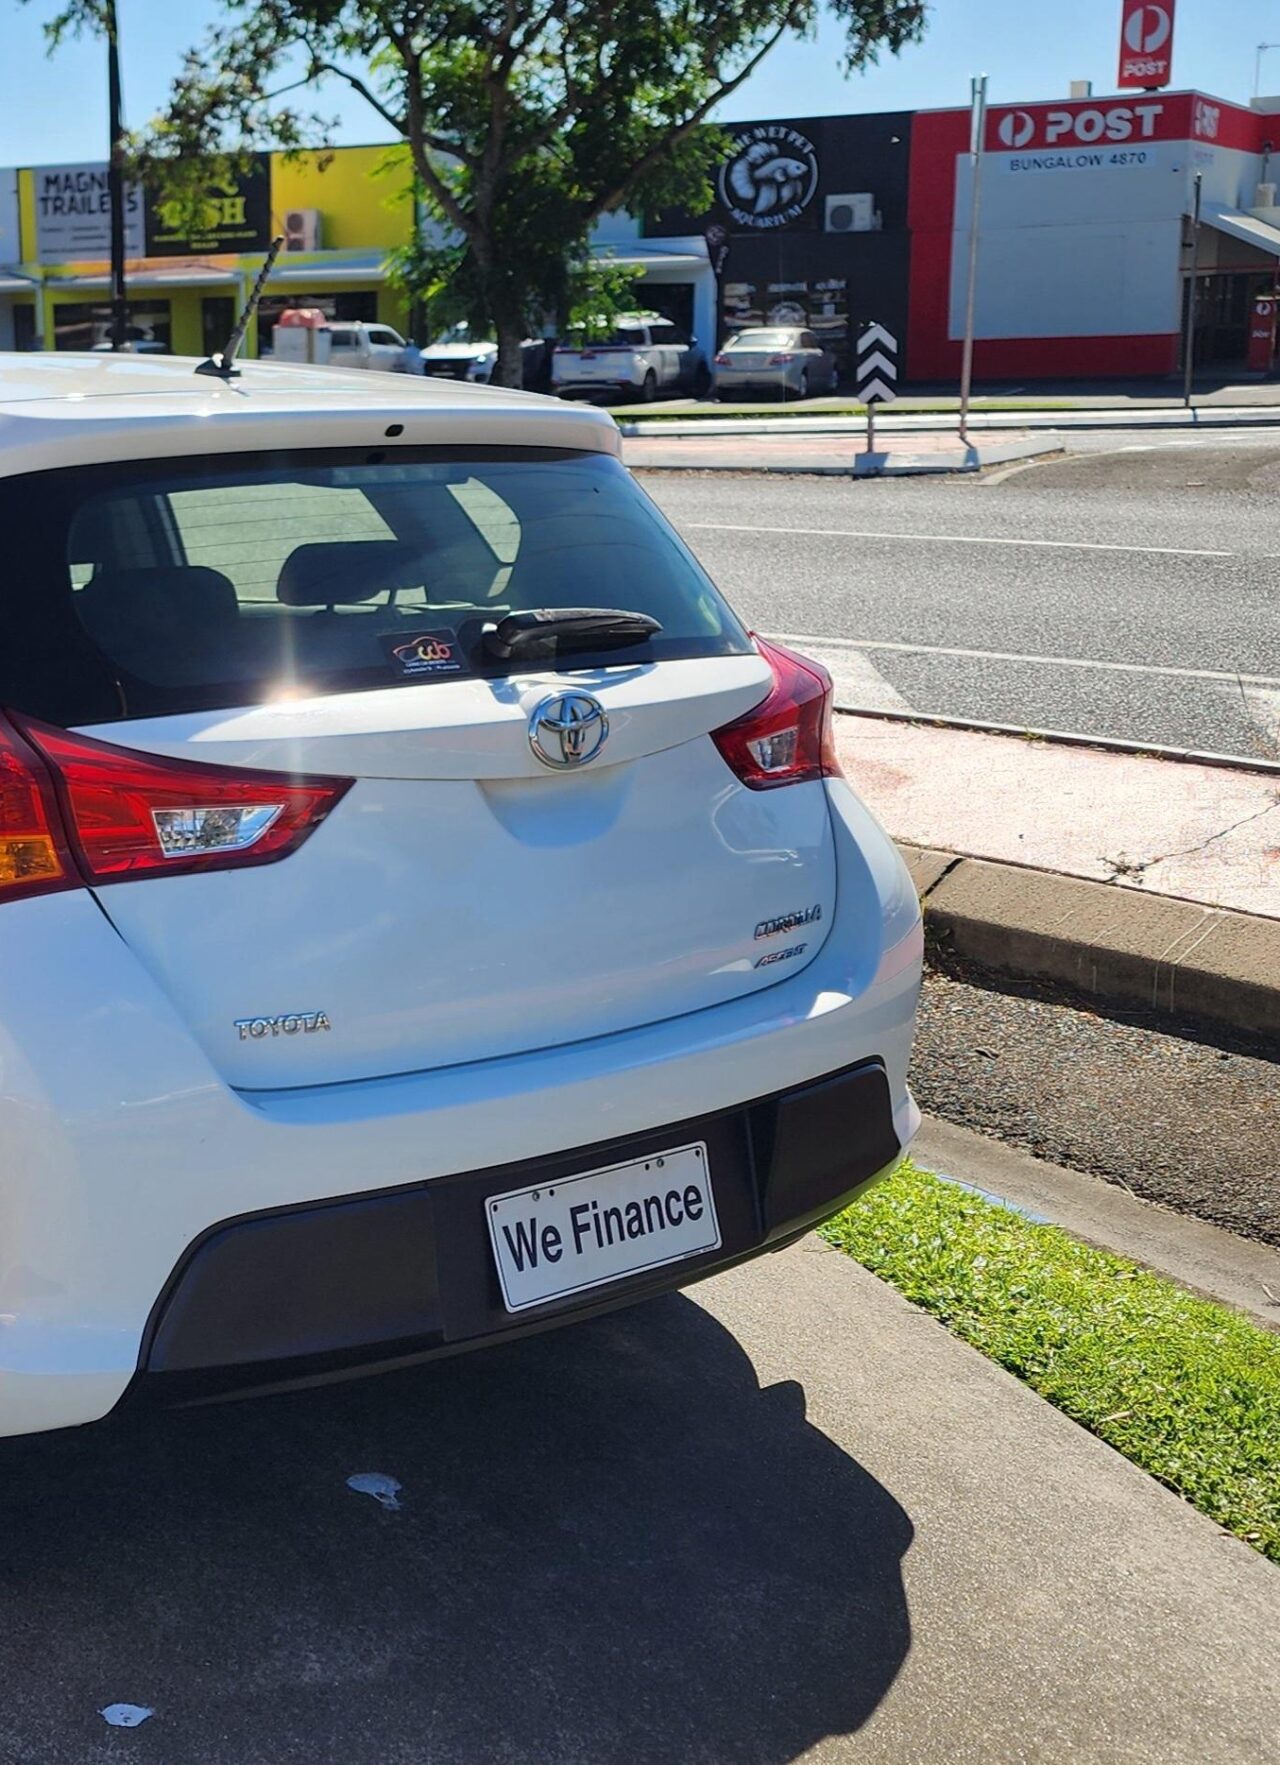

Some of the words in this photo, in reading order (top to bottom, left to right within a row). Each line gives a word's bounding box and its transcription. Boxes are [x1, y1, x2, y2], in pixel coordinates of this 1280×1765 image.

[1123, 60, 1168, 78] POST
[1045, 104, 1164, 143] POST
[753, 126, 788, 139] WET
[787, 130, 816, 153] PET
[1009, 154, 1104, 172] BUNGALOW
[1109, 151, 1148, 166] 4870
[39, 190, 139, 217] TRAILES
[731, 204, 803, 229] AQUARIUM
[233, 1010, 332, 1041] TOYOTA
[501, 1217, 564, 1273] We
[570, 1184, 704, 1255] Finance
